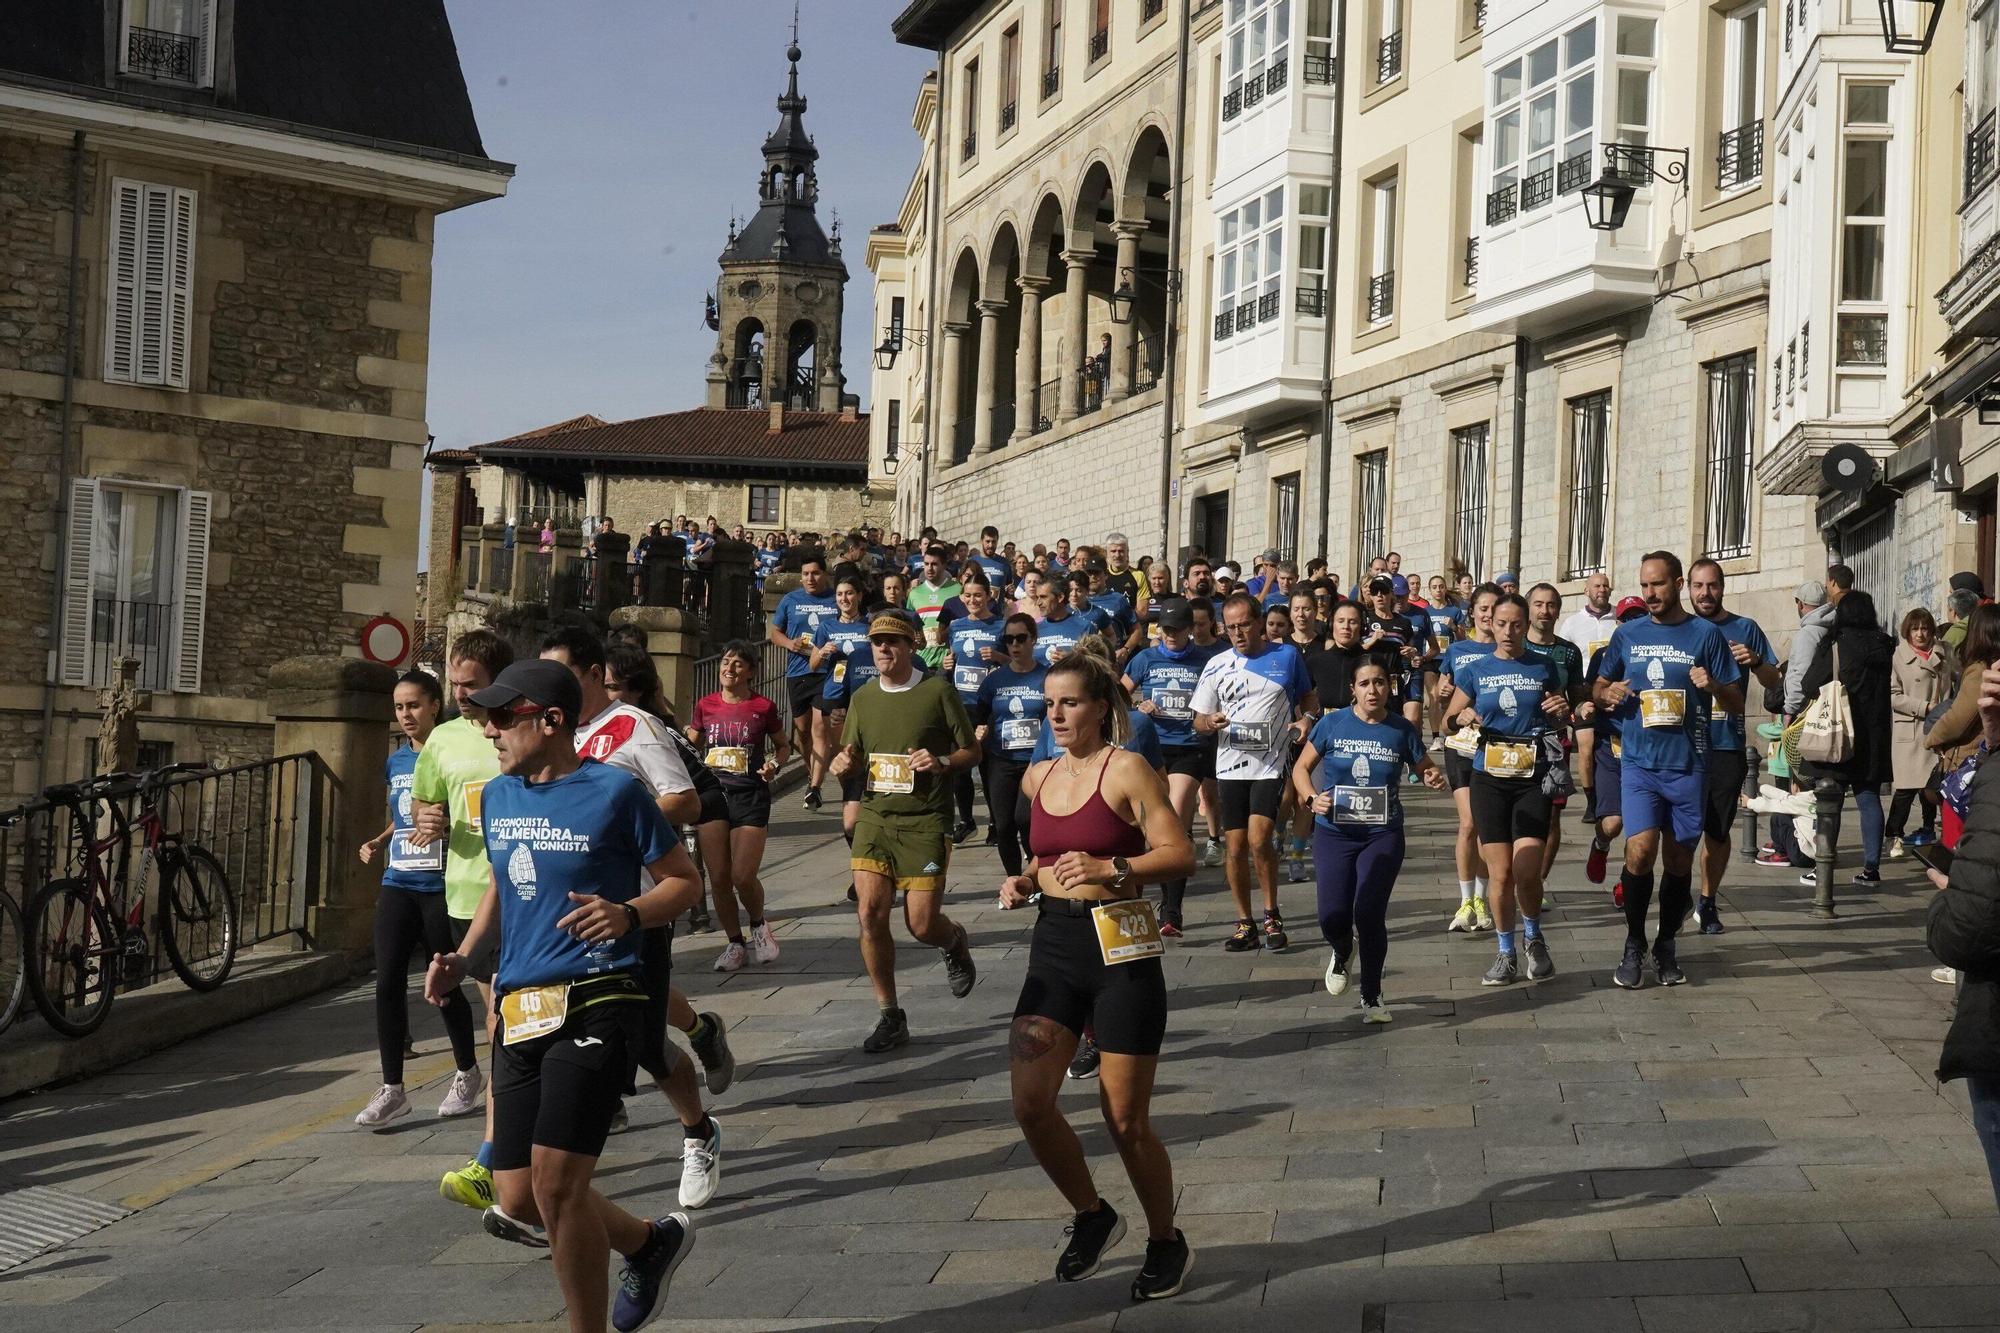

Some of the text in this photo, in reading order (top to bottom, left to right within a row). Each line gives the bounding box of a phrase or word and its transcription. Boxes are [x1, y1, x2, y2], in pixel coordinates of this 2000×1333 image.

[1965, 511, 1971, 522] 2
[1638, 650, 1686, 658] ALMENDRA
[963, 672, 978, 683] 740
[1486, 674, 1523, 682] CONQUISTA
[1488, 678, 1536, 688] ALMENDRA
[1161, 696, 1186, 709] 1016
[1652, 698, 1670, 712] 34
[1011, 726, 1031, 738] 953
[1236, 729, 1262, 741] 1044
[1342, 739, 1381, 748] CONQUISTA
[1343, 745, 1393, 756] ALMENDRA
[715, 755, 736, 767] 464
[1502, 751, 1518, 765] 29
[879, 763, 900, 779] 391
[1349, 796, 1372, 810] 782
[491, 817, 550, 828] LA CONQUISTA
[498, 828, 572, 841] ALMENDRA
[533, 841, 590, 852] KONKISTA
[1119, 914, 1149, 938] 423
[520, 992, 542, 1015] 46
